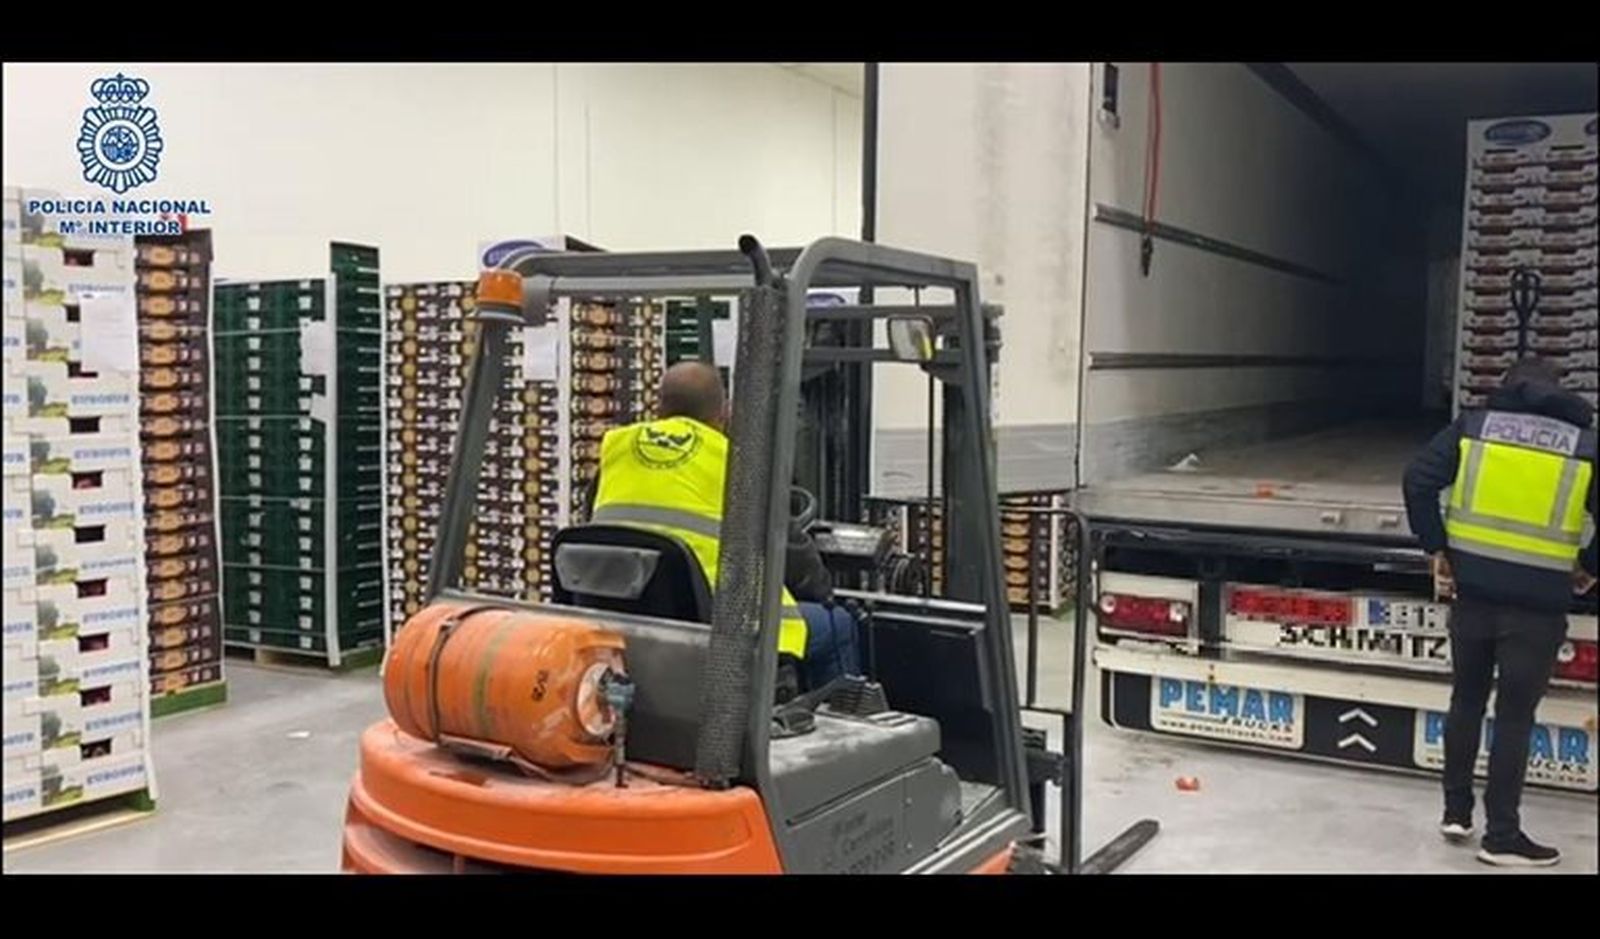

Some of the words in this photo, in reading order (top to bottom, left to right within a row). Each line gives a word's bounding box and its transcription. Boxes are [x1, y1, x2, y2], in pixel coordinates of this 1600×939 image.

[1486, 423, 1572, 452] POLICIA
[1279, 623, 1447, 660] SCHMITZ
[1159, 677, 1294, 725] PEMAR
[1221, 716, 1293, 733] TRUCKS
